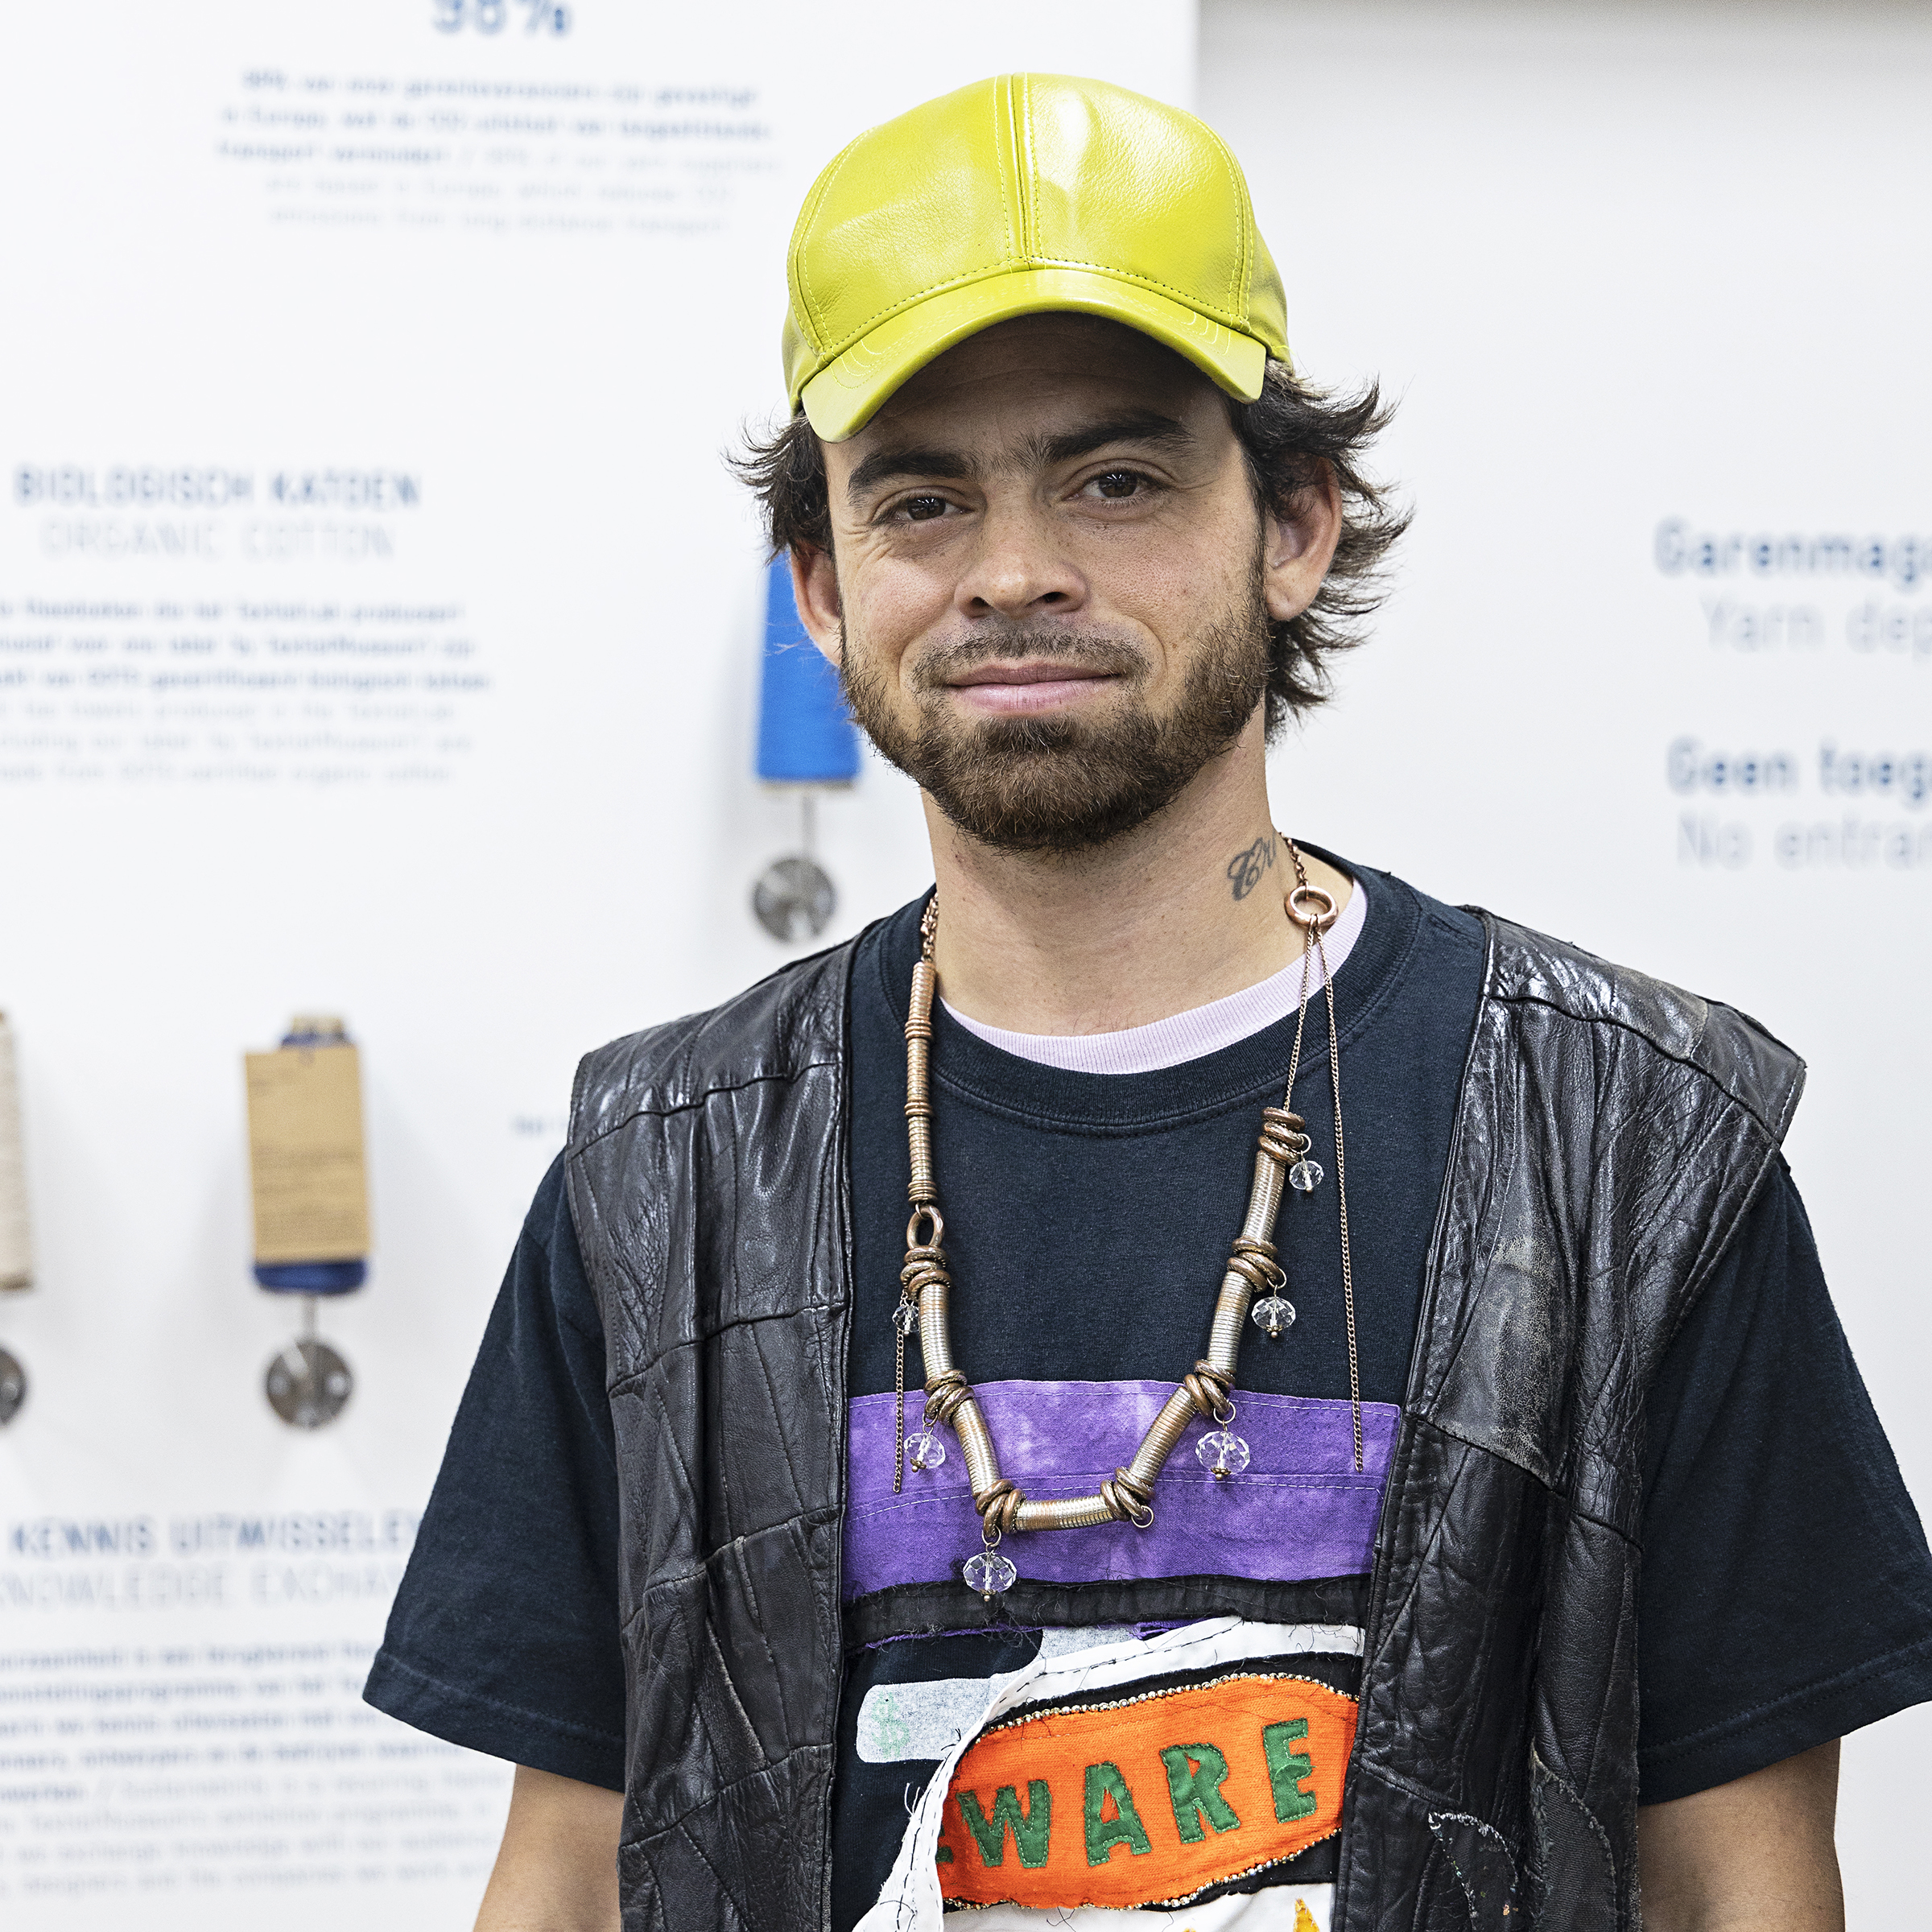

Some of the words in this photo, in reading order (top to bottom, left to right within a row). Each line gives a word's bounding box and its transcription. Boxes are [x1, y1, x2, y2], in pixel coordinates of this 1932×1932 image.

[267, 468, 422, 512] KATOEN
[40, 519, 227, 562] ORGANIC
[243, 520, 394, 562] COTTON
[1700, 590, 1825, 652] Yarn
[1666, 734, 1800, 797] Geen
[1678, 810, 1753, 872] No
[11, 1517, 155, 1559] KENNIS
[0, 1565, 229, 1609] NOWLEDGE
